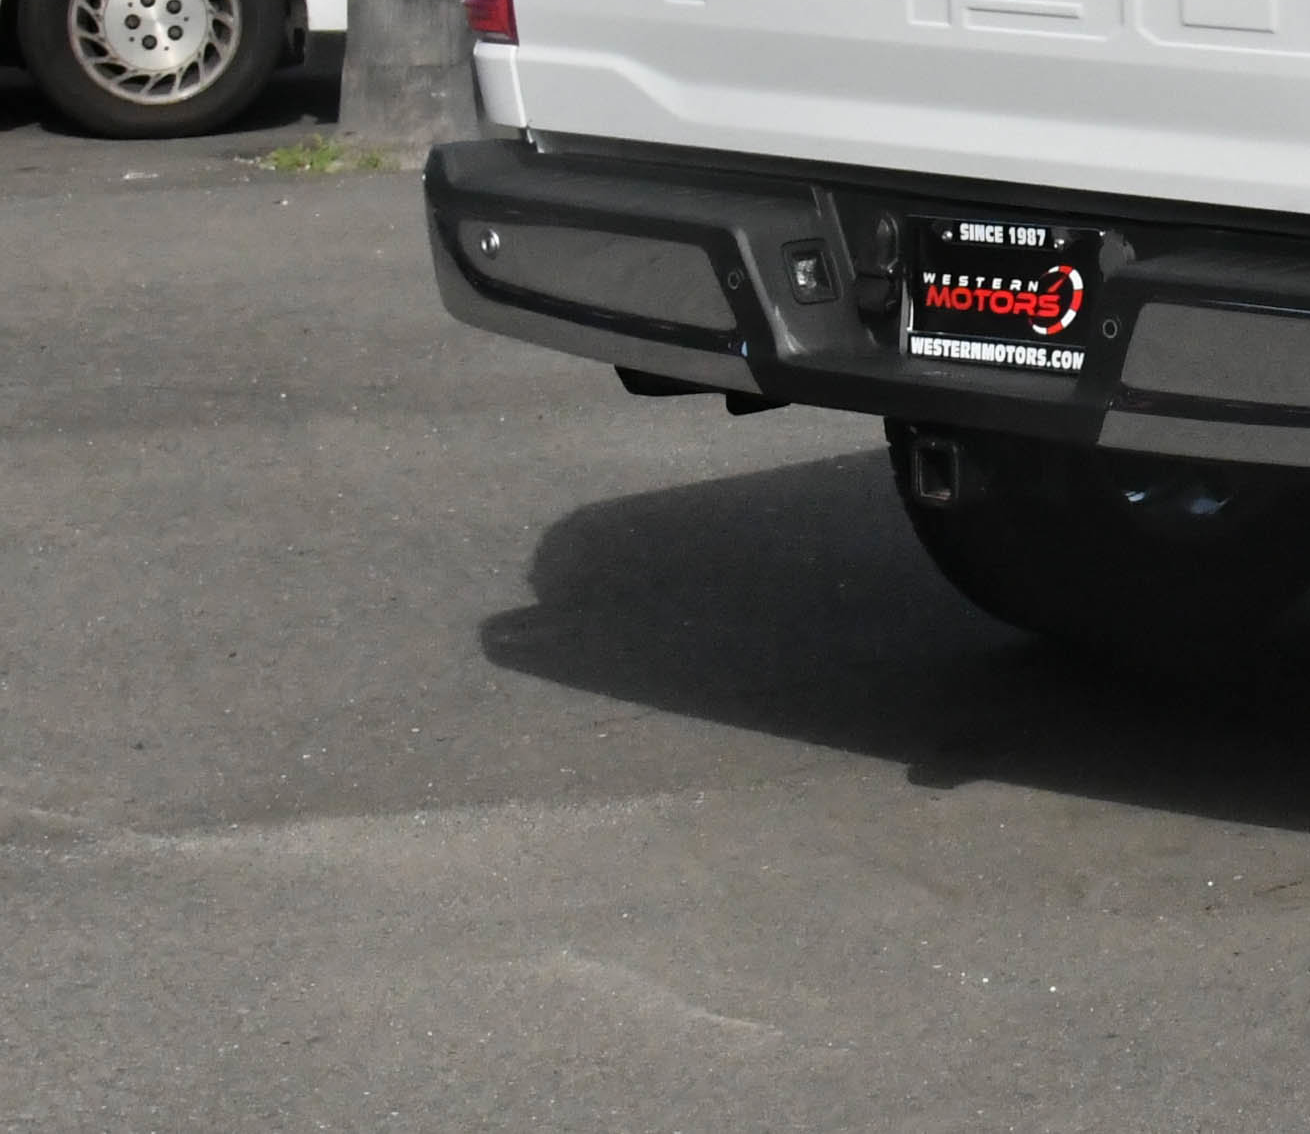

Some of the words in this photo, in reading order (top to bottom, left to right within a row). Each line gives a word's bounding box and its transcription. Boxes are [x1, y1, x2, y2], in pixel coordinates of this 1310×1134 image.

[959, 223, 1003, 243] SINCE
[1009, 227, 1046, 246] 1987
[923, 272, 1038, 292] WESTERN
[926, 285, 1060, 318] MOTORS
[911, 336, 1085, 370] WESTERNMOTORS.COM
